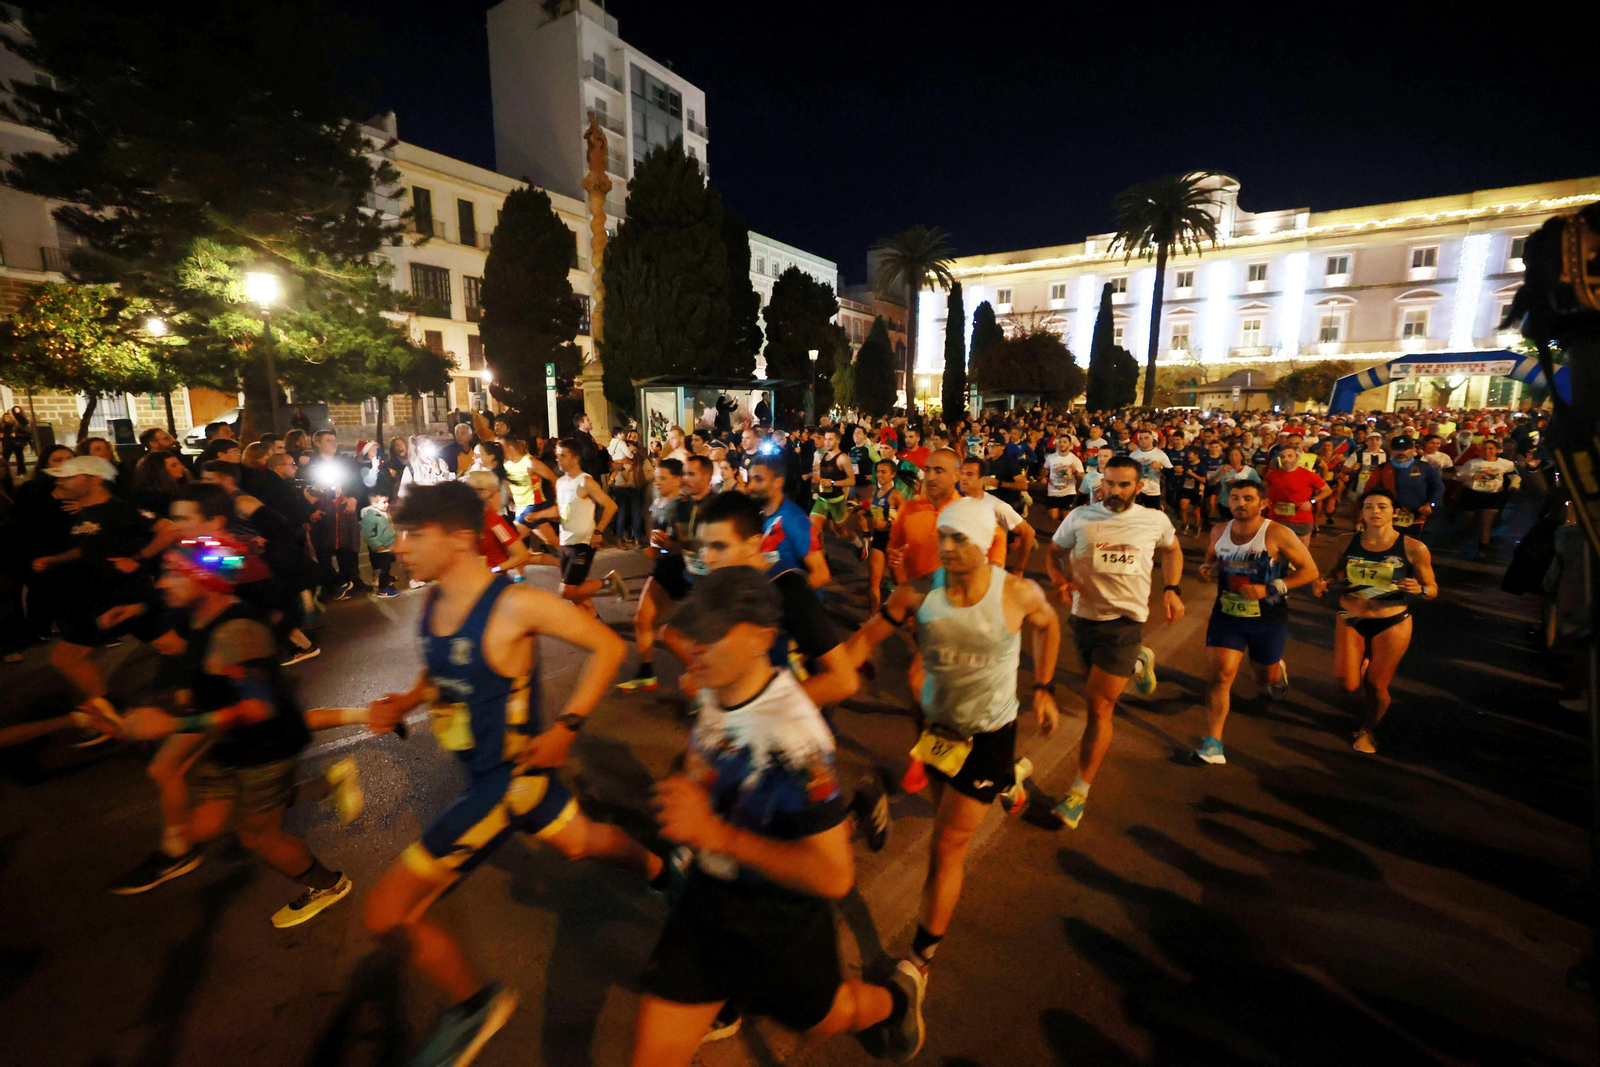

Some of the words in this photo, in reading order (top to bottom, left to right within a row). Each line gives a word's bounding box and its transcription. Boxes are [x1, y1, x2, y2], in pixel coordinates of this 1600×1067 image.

[1101, 553, 1134, 564] 1545
[1359, 569, 1378, 579] 17
[1229, 601, 1246, 612] 76
